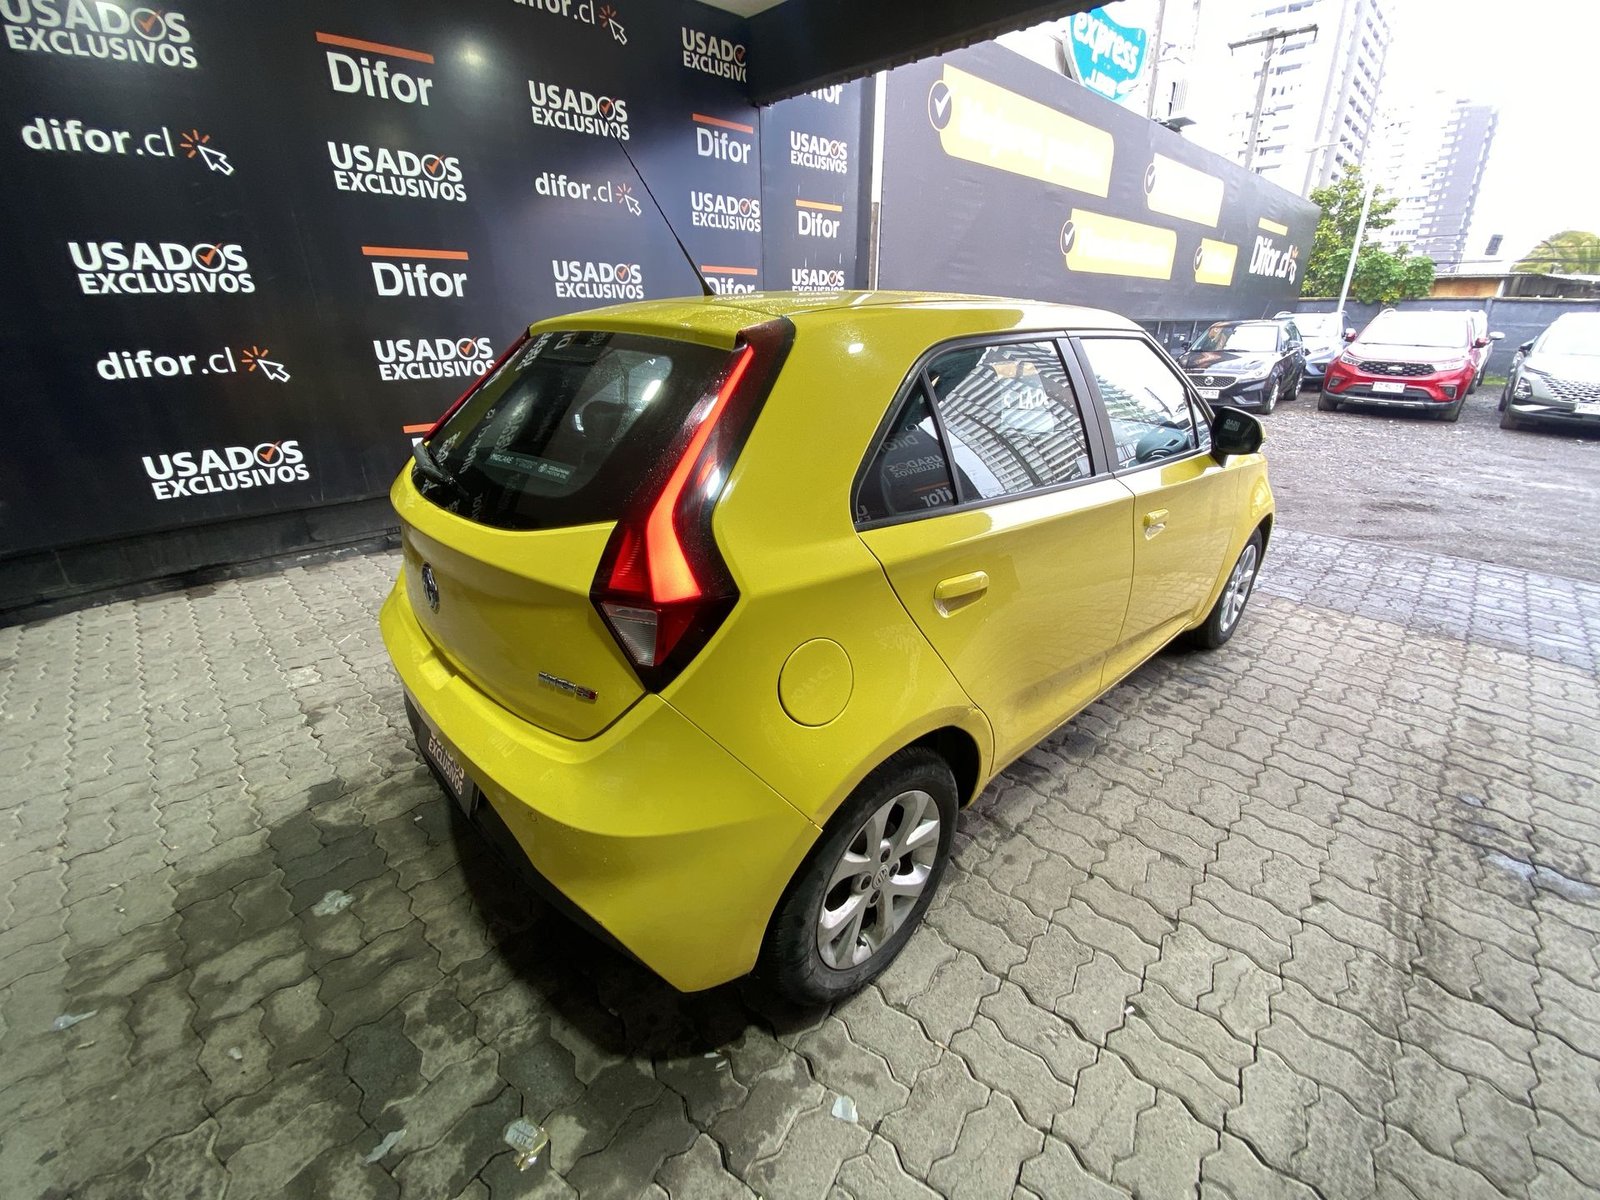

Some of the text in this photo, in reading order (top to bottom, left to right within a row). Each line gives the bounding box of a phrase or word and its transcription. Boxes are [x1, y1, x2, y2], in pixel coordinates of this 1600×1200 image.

[0, 0, 192, 43] USADOS
[513, 0, 595, 24] or.cl
[4, 24, 198, 69] EXCLUSIVOS
[1073, 11, 1139, 74] express
[326, 51, 433, 106] Difor
[528, 80, 628, 123] USADOS
[21, 118, 175, 157] difor.cl
[532, 106, 630, 140] EXCLUSIVOS
[696, 127, 751, 164] Difor
[790, 131, 848, 161] USADOS
[327, 141, 463, 183] USADOS
[790, 150, 848, 174] EXCLUSIVOS
[333, 170, 467, 202] EXCLUSIVOS
[534, 172, 613, 203] difor.cl
[691, 191, 760, 218] USADOS
[692, 213, 761, 233] EXCLUSIVOS
[798, 210, 840, 238] Difor
[68, 242, 248, 273] USADOS
[552, 260, 642, 284] USADOS
[77, 273, 256, 295] EXCLUSIVOS
[371, 262, 468, 297] Difor
[555, 282, 644, 299] EXCLUSIVOS
[791, 268, 845, 286] USADOS
[97, 347, 237, 380] difor.cl
[373, 338, 494, 363] USADOS
[142, 440, 304, 480] USADOS
[151, 464, 310, 500] EXCLUSIVOS
